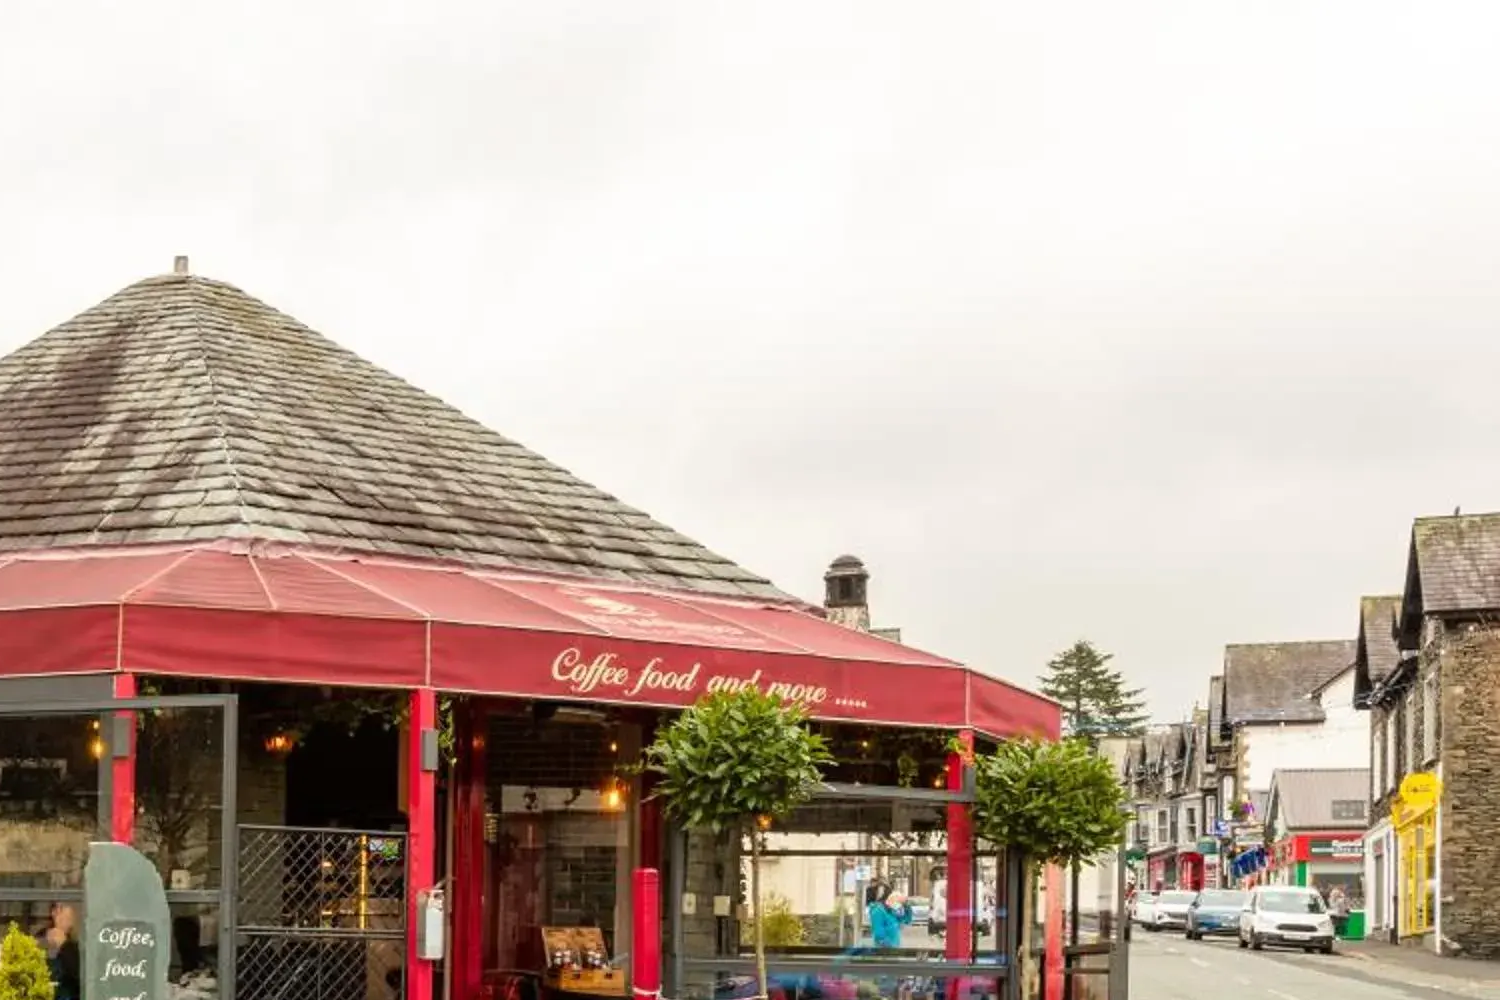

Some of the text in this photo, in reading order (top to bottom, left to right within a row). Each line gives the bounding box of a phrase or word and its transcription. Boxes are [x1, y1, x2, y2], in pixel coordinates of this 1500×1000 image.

[551, 647, 629, 692] Coffee
[625, 658, 700, 695] food
[706, 669, 762, 694] and
[763, 680, 828, 704] more
[99, 926, 155, 949] Coffee,
[100, 959, 146, 981] food,
